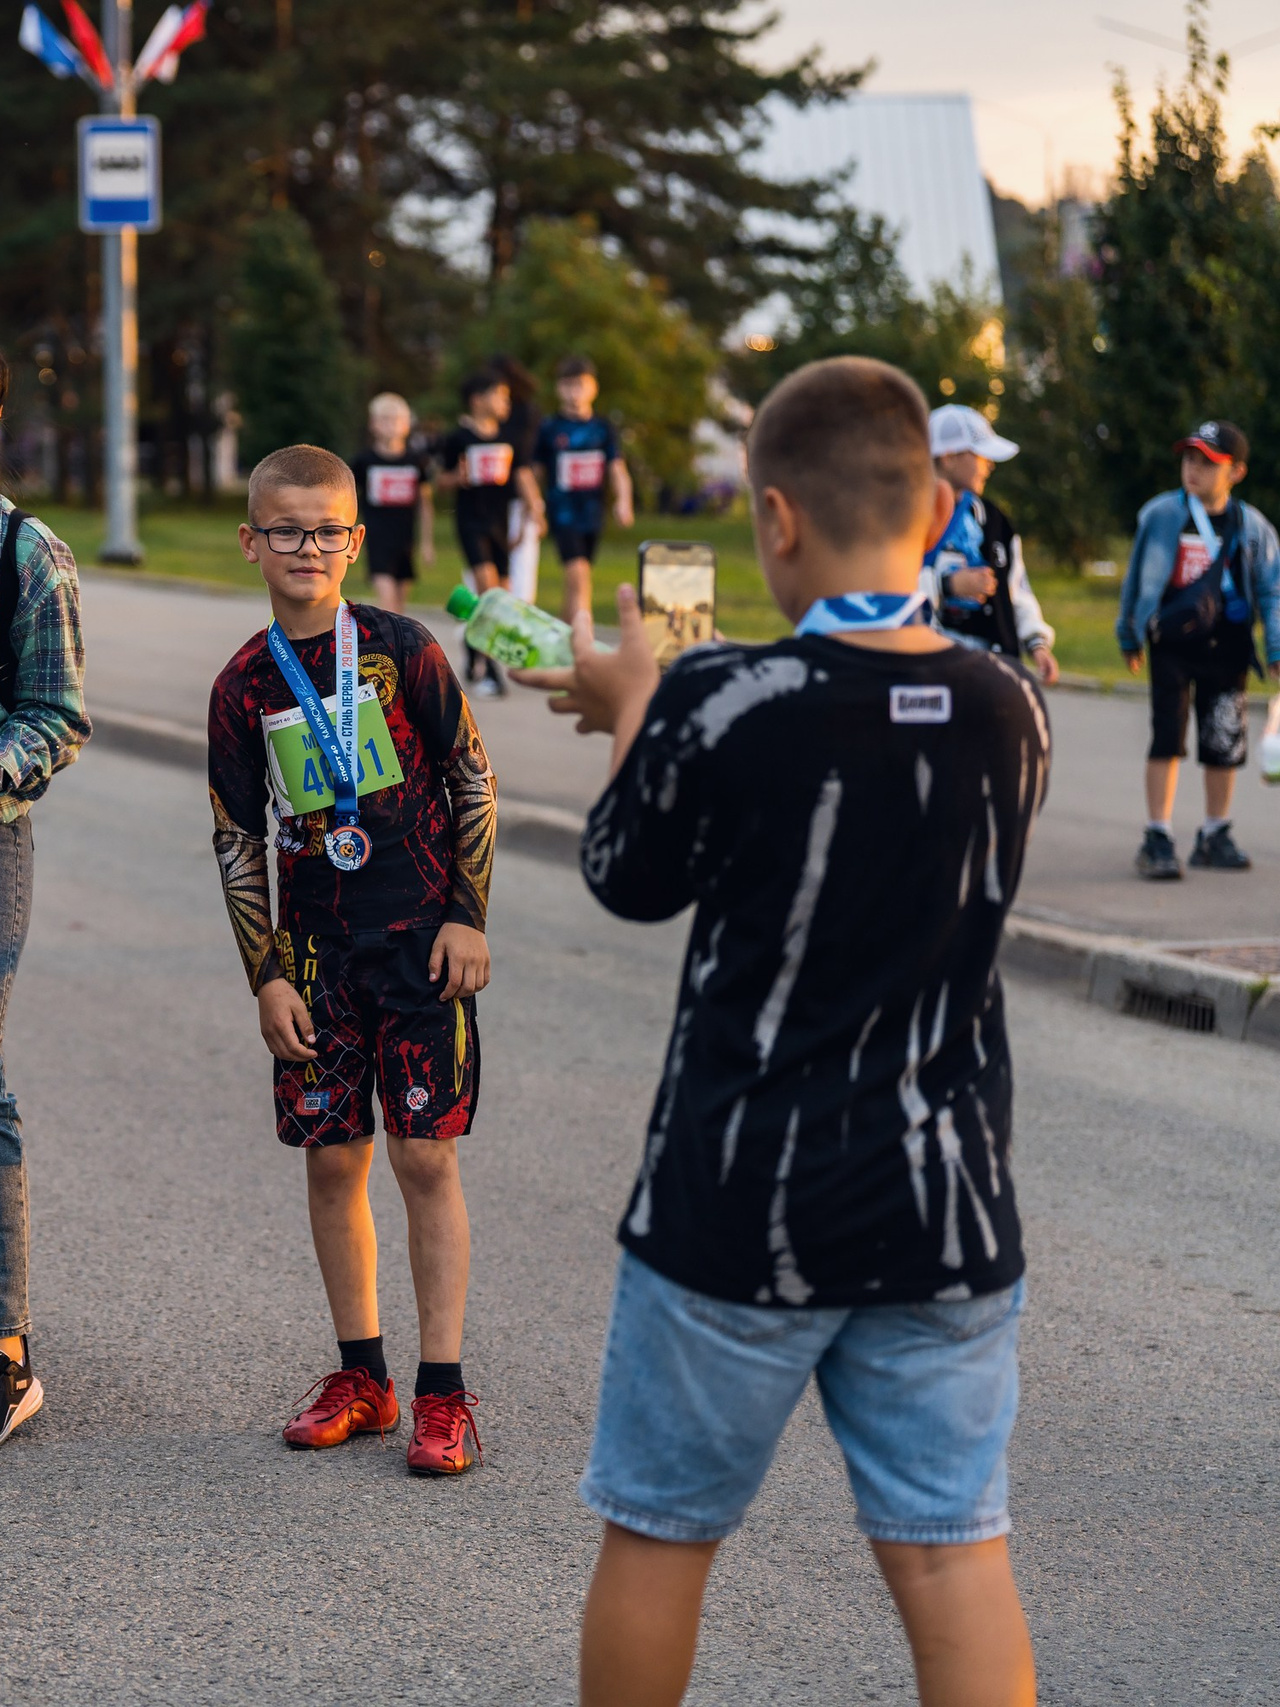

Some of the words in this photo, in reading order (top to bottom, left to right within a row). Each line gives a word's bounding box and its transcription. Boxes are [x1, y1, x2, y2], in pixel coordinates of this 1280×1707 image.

[270, 631, 289, 661] МАРАФОН
[342, 622, 352, 653] АВГУСТА
[342, 657, 352, 667] 29
[342, 670, 353, 706] ПЕРВЫМ
[306, 696, 330, 739] КАЛУЖСКИЙ
[342, 706, 353, 738] СТАНЬ
[331, 745, 338, 755] 40
[346, 741, 352, 751] 40
[335, 756, 348, 782] СПОРТ
